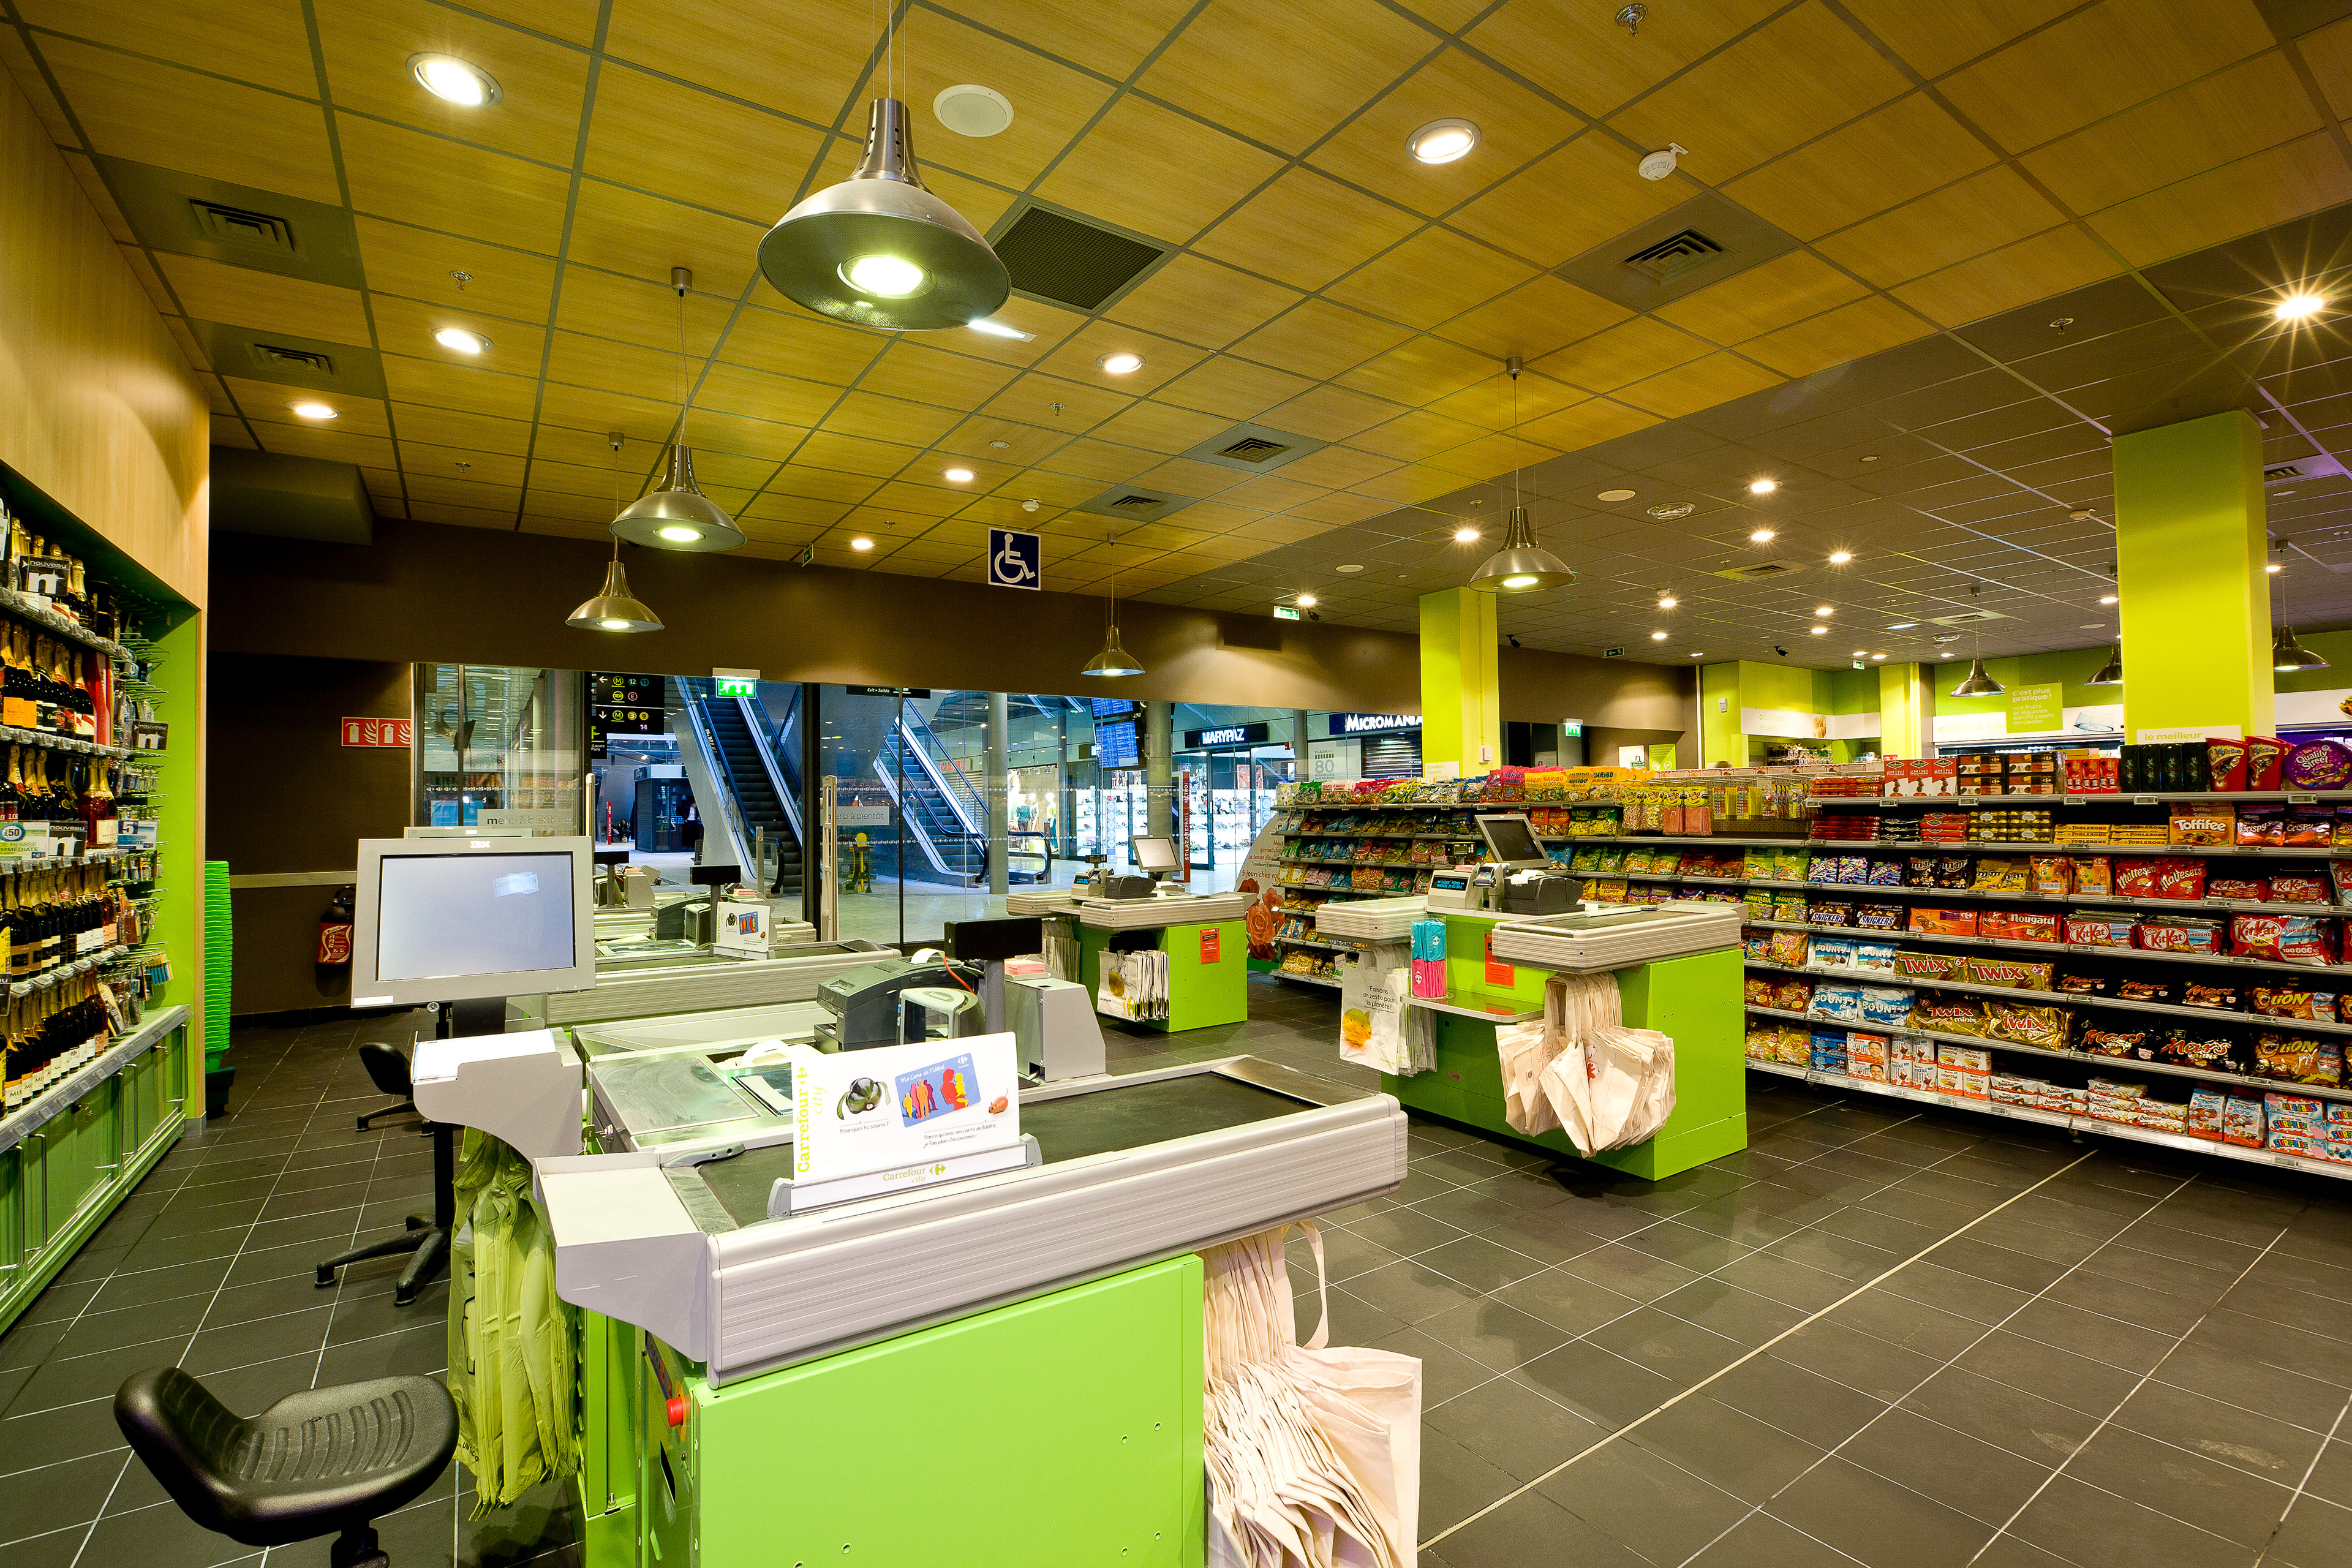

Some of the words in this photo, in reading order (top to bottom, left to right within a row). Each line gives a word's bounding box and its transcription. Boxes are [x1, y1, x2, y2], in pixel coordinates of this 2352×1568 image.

[30, 560, 67, 568] nouveau
[2013, 695, 2048, 703] pratique
[1346, 713, 1423, 732] MICROMANIA
[1939, 724, 1961, 733] c'est
[1202, 728, 1245, 745] MARYPAZ
[2296, 750, 2328, 764] Quality
[1315, 760, 1334, 774] 80
[2302, 756, 2328, 771] Street
[2174, 818, 2226, 832] Toffifee
[2241, 823, 2267, 833] Crispy
[2286, 823, 2313, 832] Crispy
[1245, 870, 1258, 878] jours
[2117, 865, 2157, 889] Maltesers
[2159, 867, 2203, 892] Maltesers
[1744, 894, 1771, 905] PHANTASIA
[1775, 896, 1806, 905] PHANTASIA
[1812, 913, 1845, 923] SNICKERS
[1860, 915, 1895, 926] SNICKERS
[2010, 913, 2055, 925] Nougatti
[2076, 924, 2105, 940] KitKat
[2237, 921, 2276, 939] KitKat
[2152, 927, 2183, 948] KitKat
[1815, 944, 1849, 954] BOUNTY
[1858, 948, 1893, 958] BOUNTY
[1370, 986, 1389, 994] Faisons
[2121, 981, 2168, 990] Mars
[2185, 985, 2235, 996] Mars
[1814, 993, 1856, 1006] BOUNTY
[2081, 1029, 2146, 1047] Mars
[2160, 1037, 2231, 1055] Mars
[812, 1087, 827, 1114] city
[2282, 1102, 2318, 1112] SURPRISE
[796, 1088, 810, 1173] Carrefour
[840, 1126, 863, 1134] Pourquoi
[2272, 1120, 2308, 1131] SURPRISE
[938, 1131, 955, 1139] qu'avec
[948, 1134, 974, 1143] d'économies
[2273, 1139, 2309, 1150] SURPRISE
[883, 1167, 926, 1182] Carrefour
[911, 1175, 926, 1184] city
